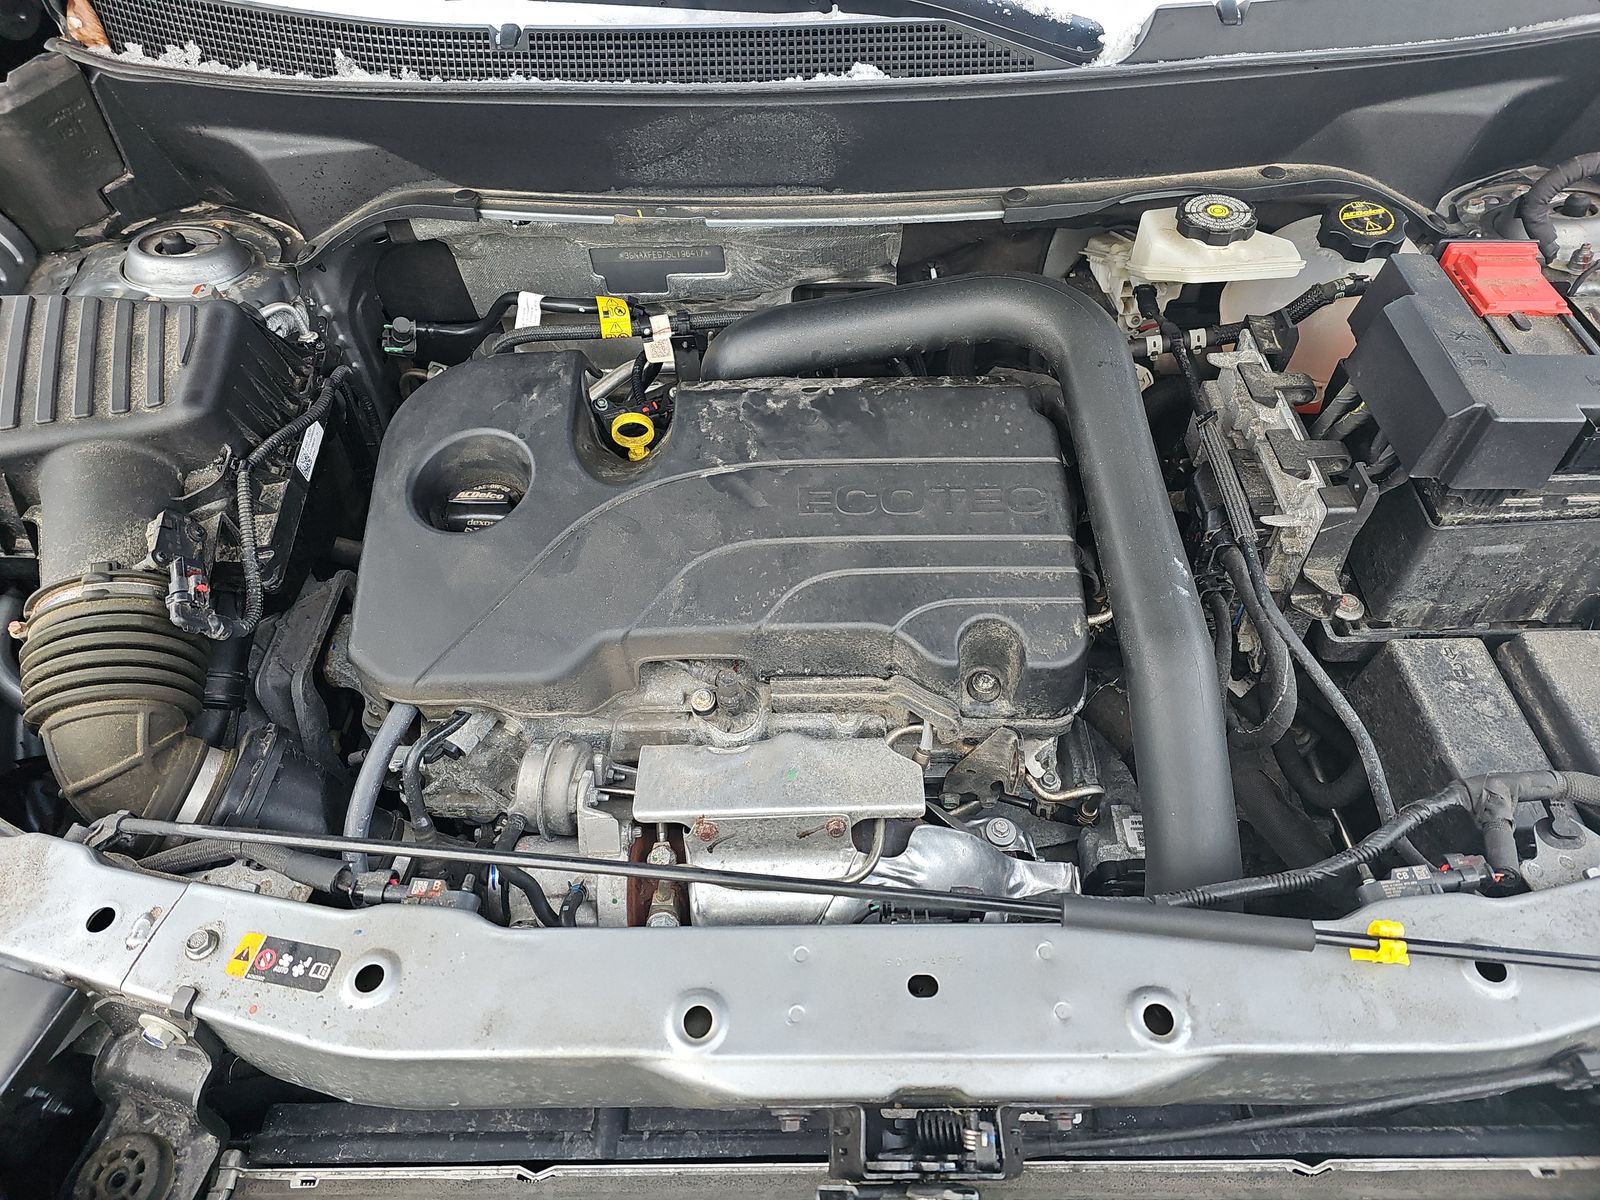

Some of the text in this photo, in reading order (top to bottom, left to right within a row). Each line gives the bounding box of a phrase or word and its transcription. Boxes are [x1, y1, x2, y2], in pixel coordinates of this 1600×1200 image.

[455, 491, 505, 500] ACDelco
[797, 486, 1048, 516] ECOTEC
[1397, 872, 1409, 880] CB
